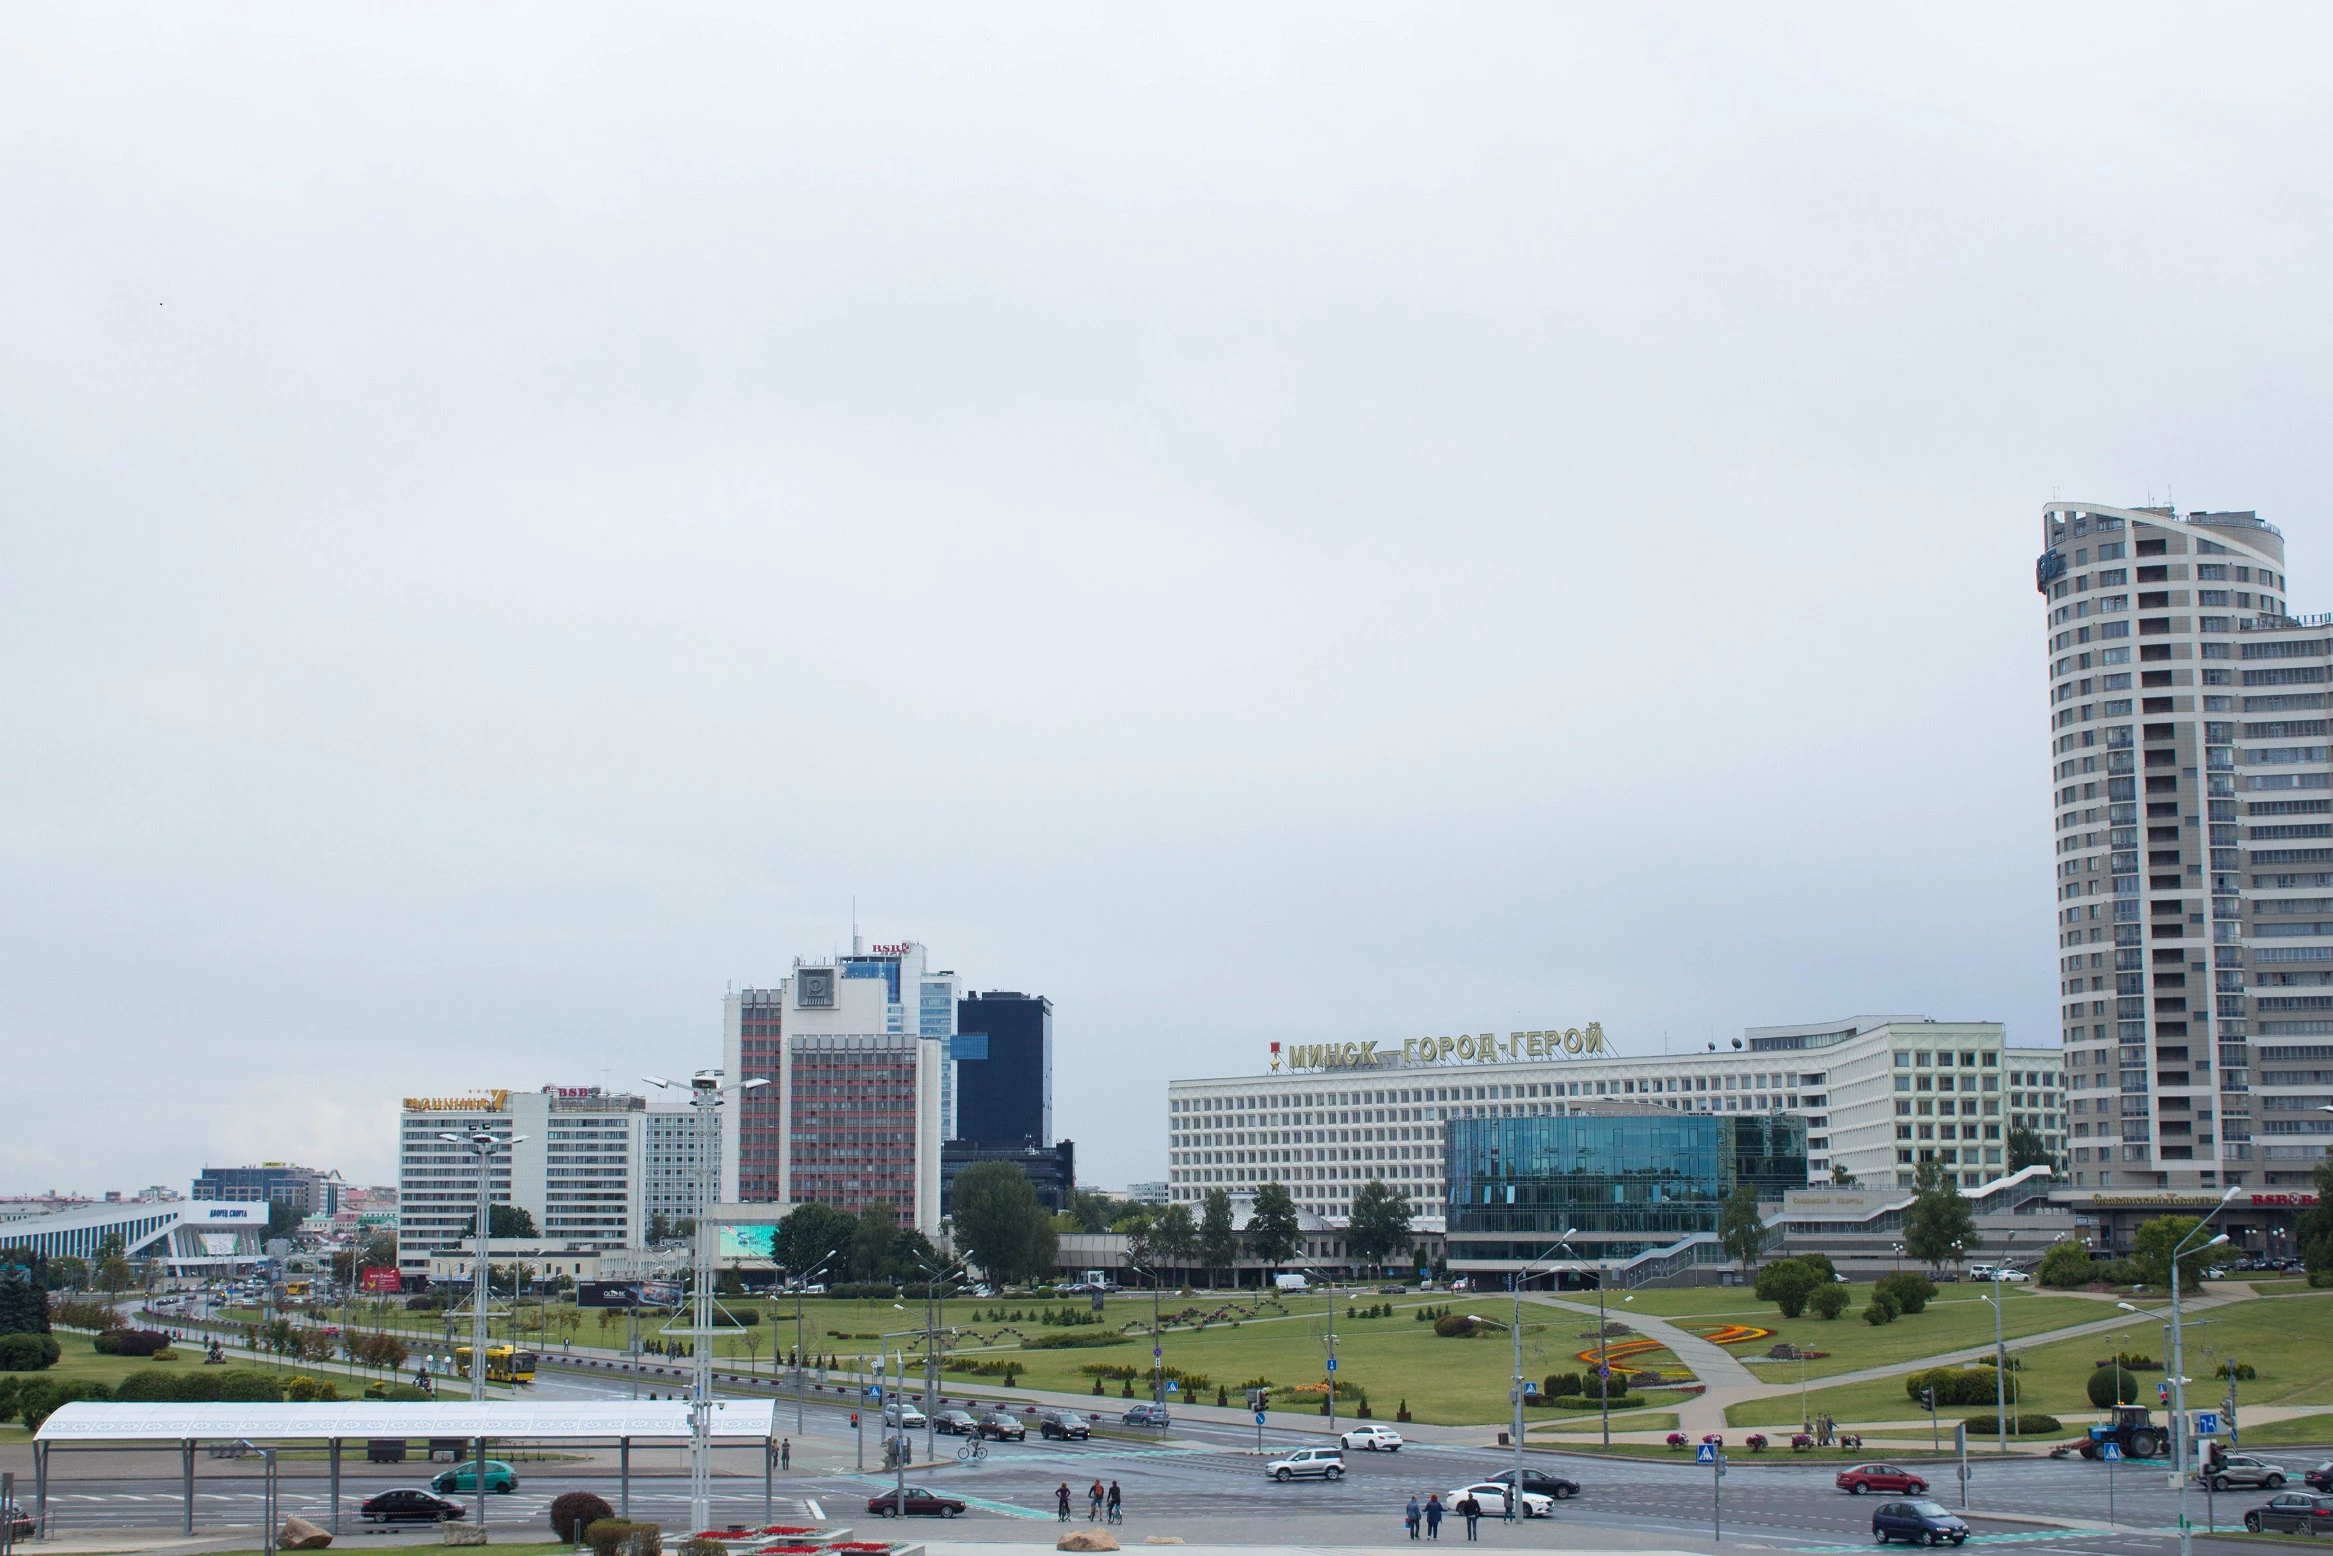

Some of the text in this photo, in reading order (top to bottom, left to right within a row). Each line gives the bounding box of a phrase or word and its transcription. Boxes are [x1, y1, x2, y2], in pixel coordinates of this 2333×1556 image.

[1289, 1040, 1378, 1068] МИНСК
[557, 1087, 589, 1097] BSB
[2251, 1194, 2289, 1206] BSB
